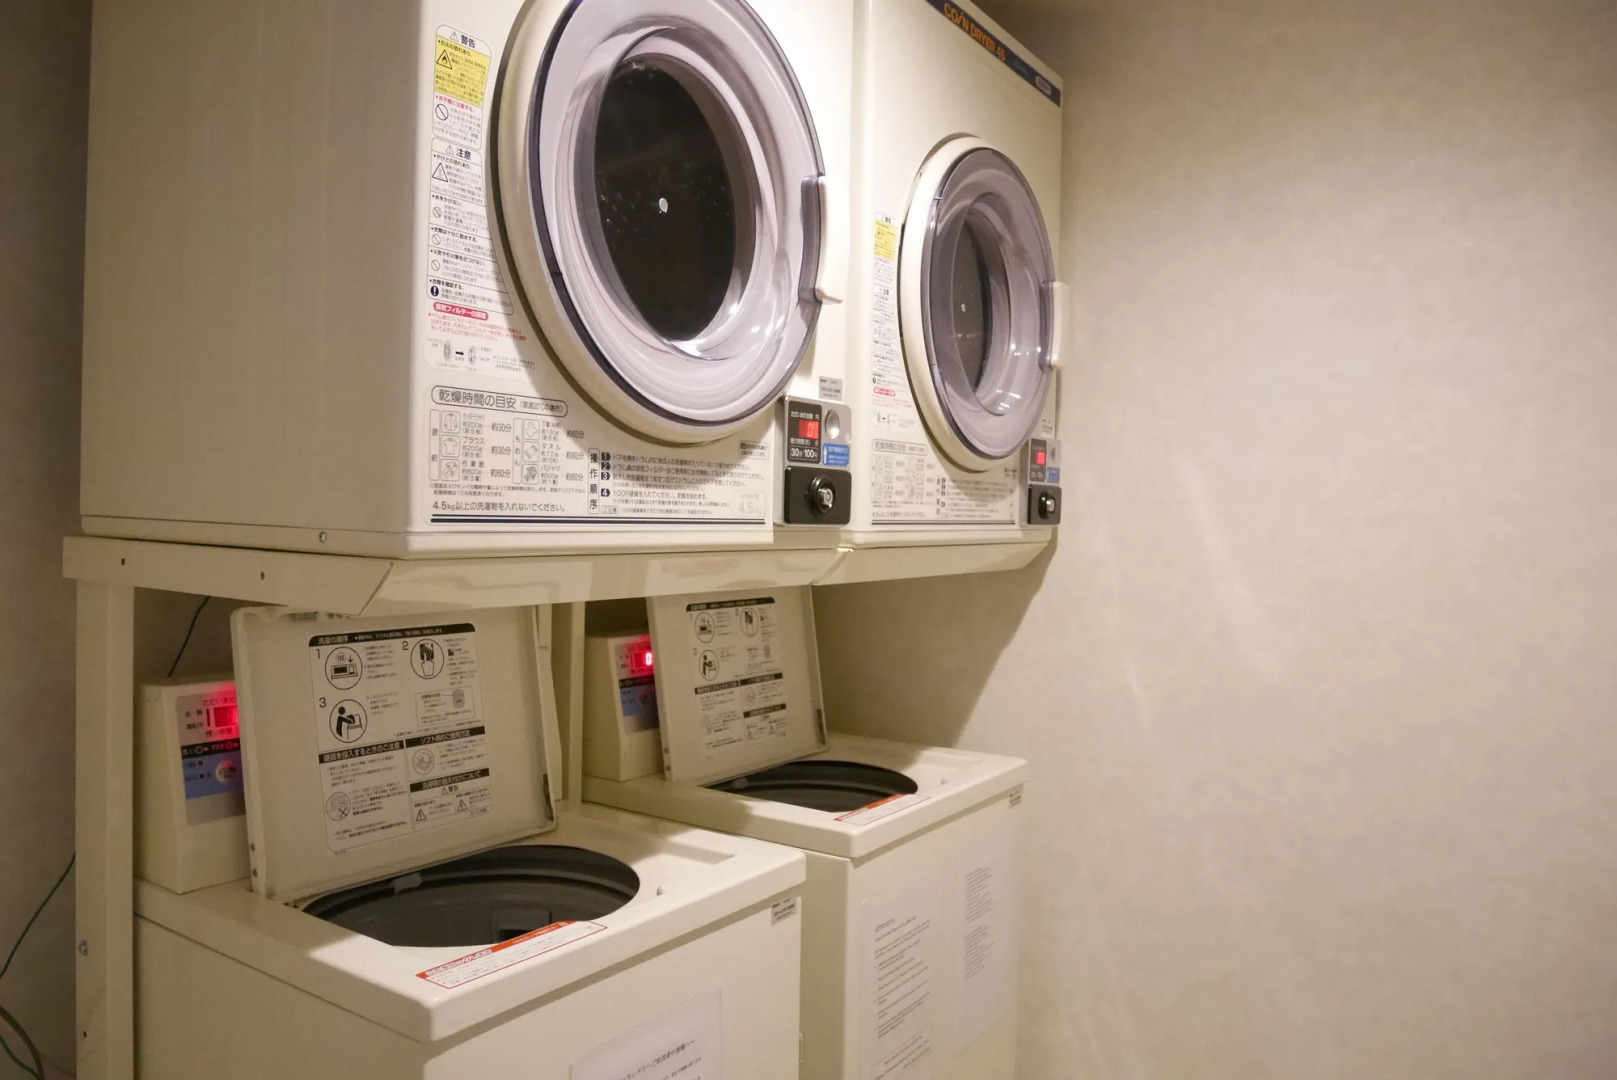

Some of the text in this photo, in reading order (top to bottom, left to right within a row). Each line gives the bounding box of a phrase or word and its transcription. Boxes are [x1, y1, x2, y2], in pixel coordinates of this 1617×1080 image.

[460, 35, 476, 49] 警告
[970, 23, 996, 53] DRYER
[456, 148, 471, 160] 注意
[439, 389, 516, 409] 乾燥時間の目安
[402, 640, 409, 651] 2
[319, 697, 327, 709] 3
